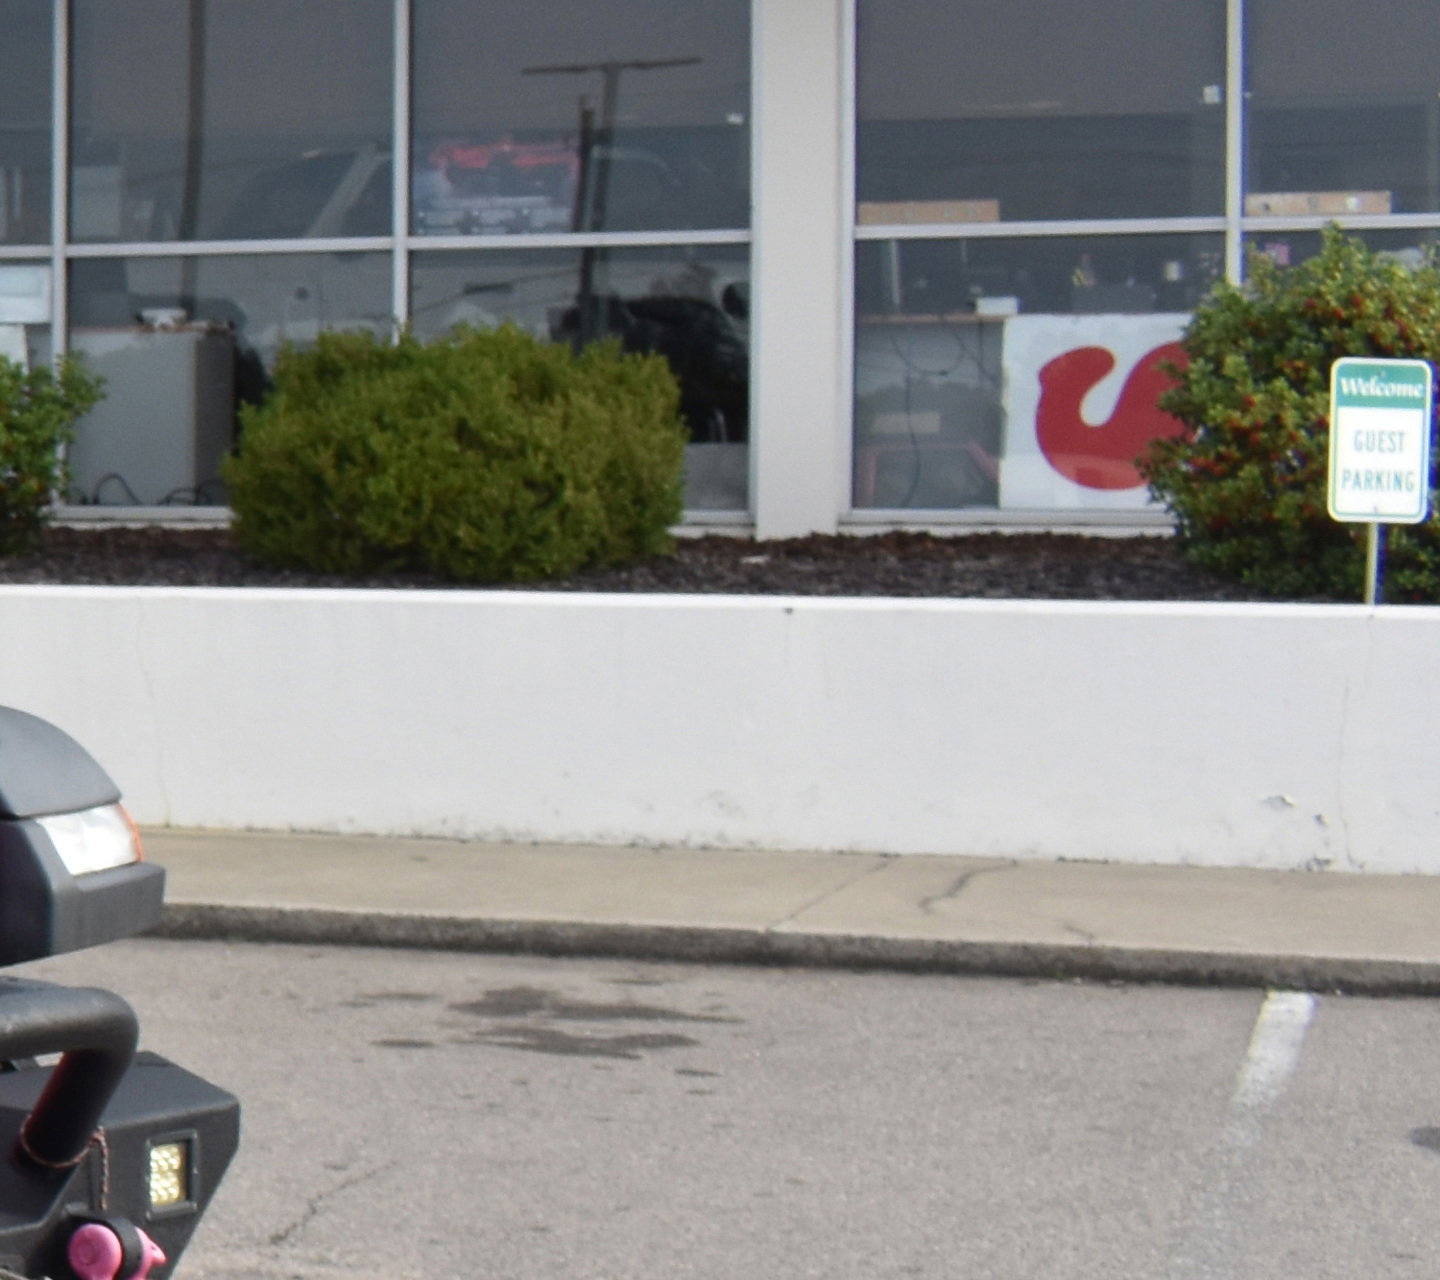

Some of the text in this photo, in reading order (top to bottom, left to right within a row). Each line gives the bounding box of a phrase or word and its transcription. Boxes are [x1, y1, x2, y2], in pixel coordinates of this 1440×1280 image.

[1340, 376, 1423, 399] Welcome
[1353, 430, 1406, 453] GUEST
[1341, 469, 1415, 492] PARKING
